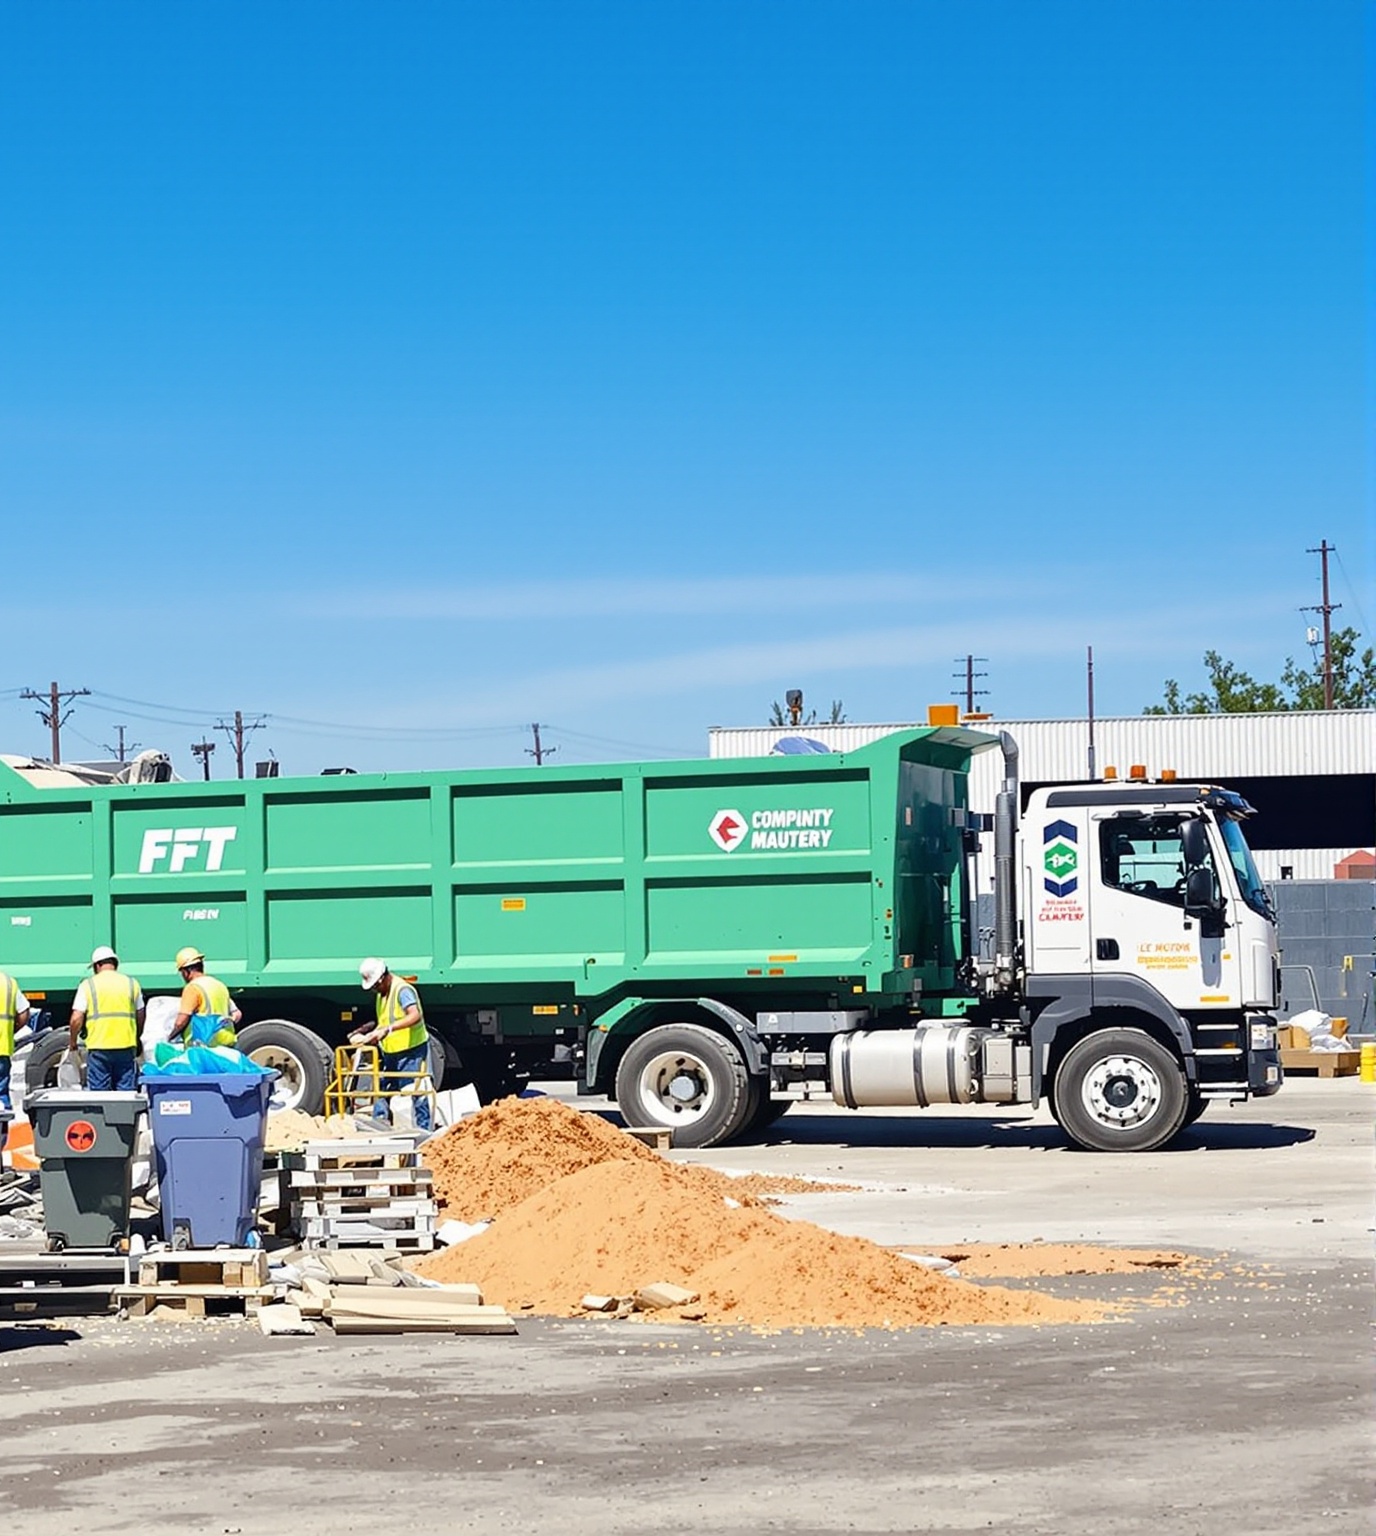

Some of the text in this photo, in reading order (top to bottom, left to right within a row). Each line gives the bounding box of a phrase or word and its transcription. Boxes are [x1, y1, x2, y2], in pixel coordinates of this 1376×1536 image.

[751, 808, 834, 829] COMPINTY
[138, 825, 237, 874] FFT
[751, 829, 833, 849] MAUTERY
